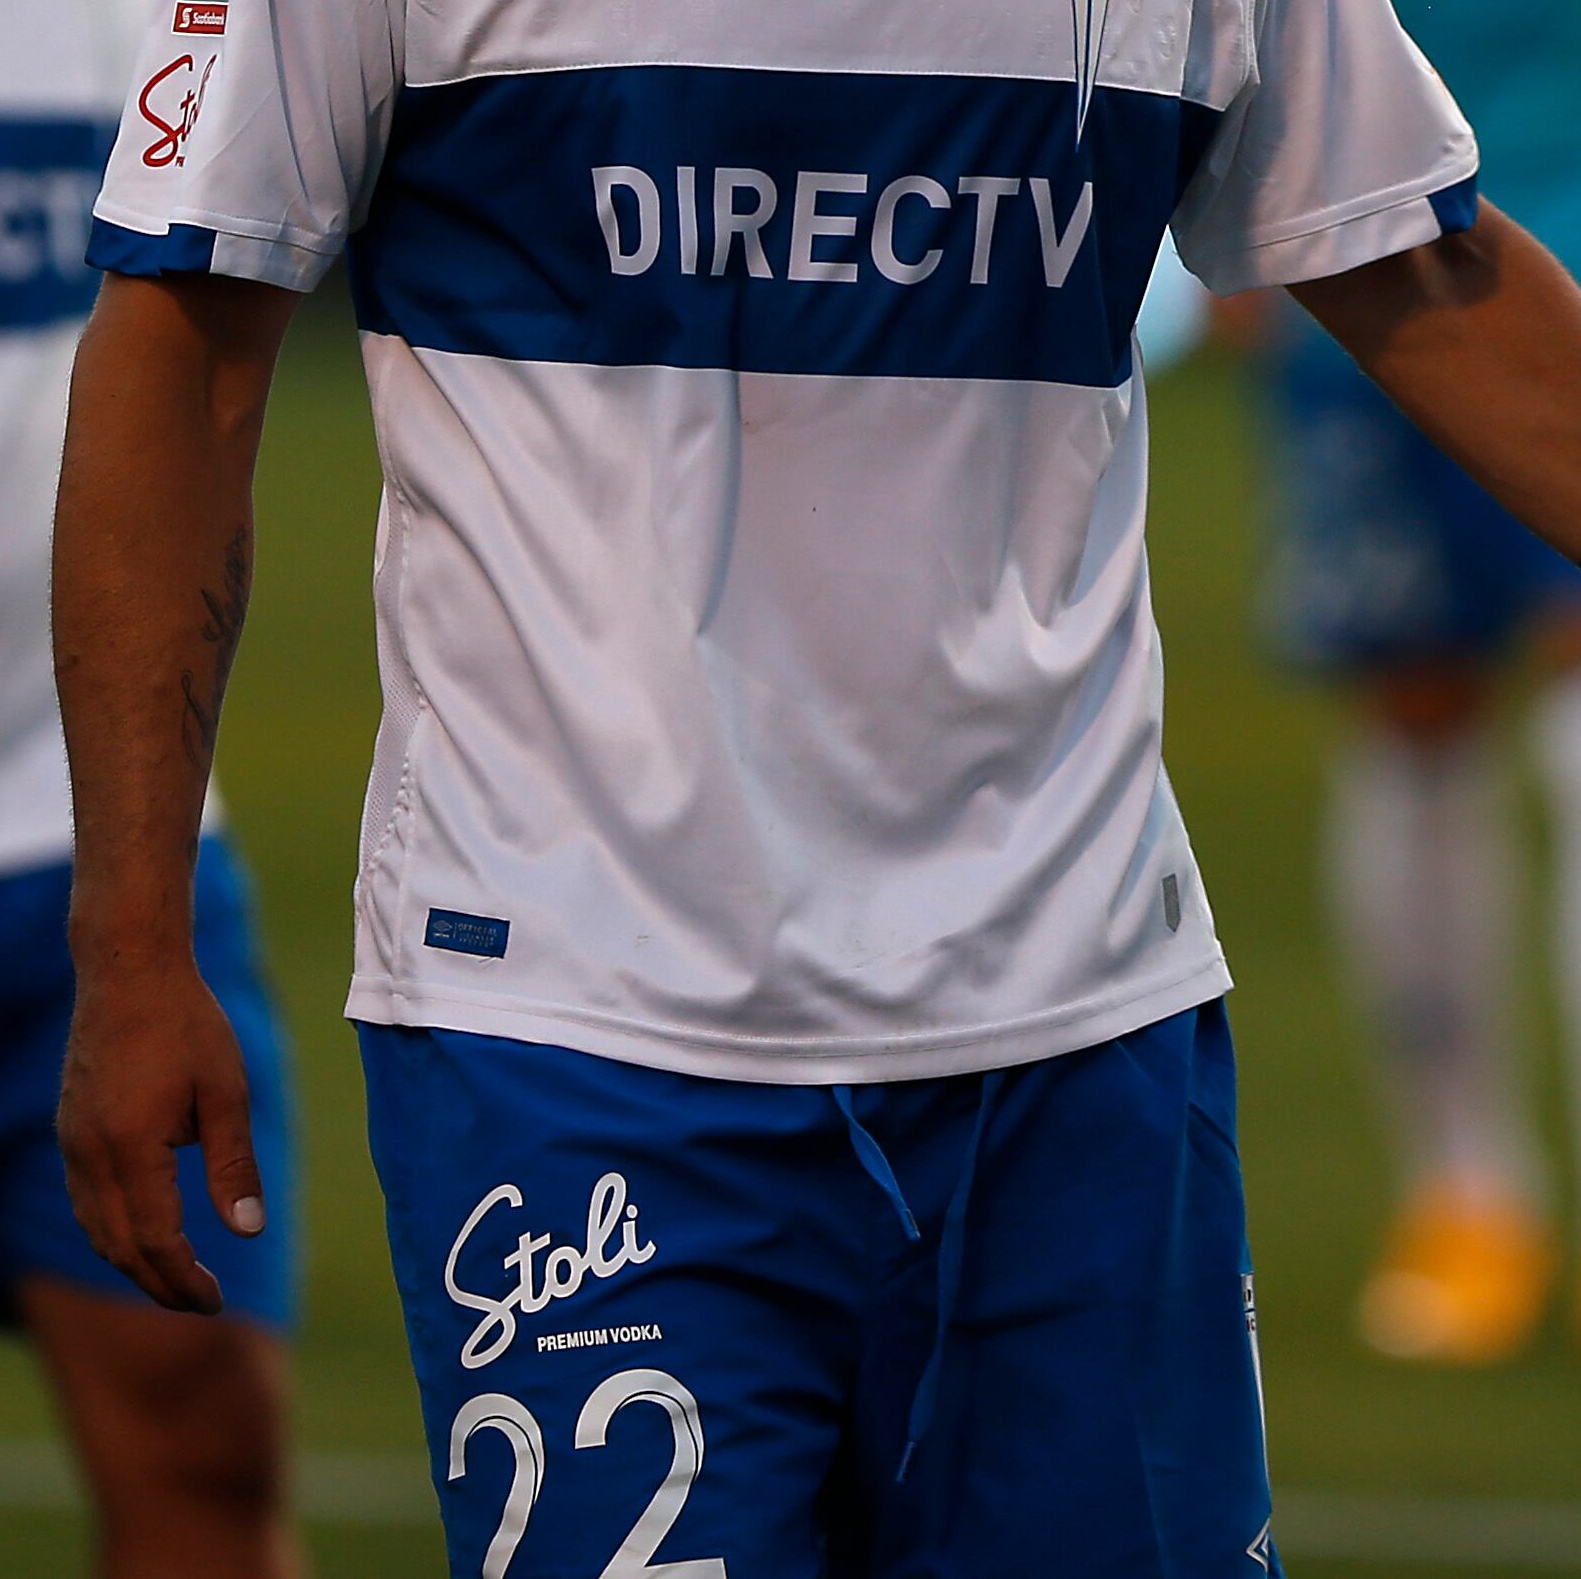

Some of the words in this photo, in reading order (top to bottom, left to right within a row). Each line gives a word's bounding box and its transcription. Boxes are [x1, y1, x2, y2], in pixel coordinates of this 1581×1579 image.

[590, 165, 1094, 289] DIRECTV
[444, 1172, 657, 1370] Stoli
[536, 1328, 609, 1353] PREMIUM
[609, 1324, 663, 1343] VODKA
[448, 1368, 727, 1579] 22
